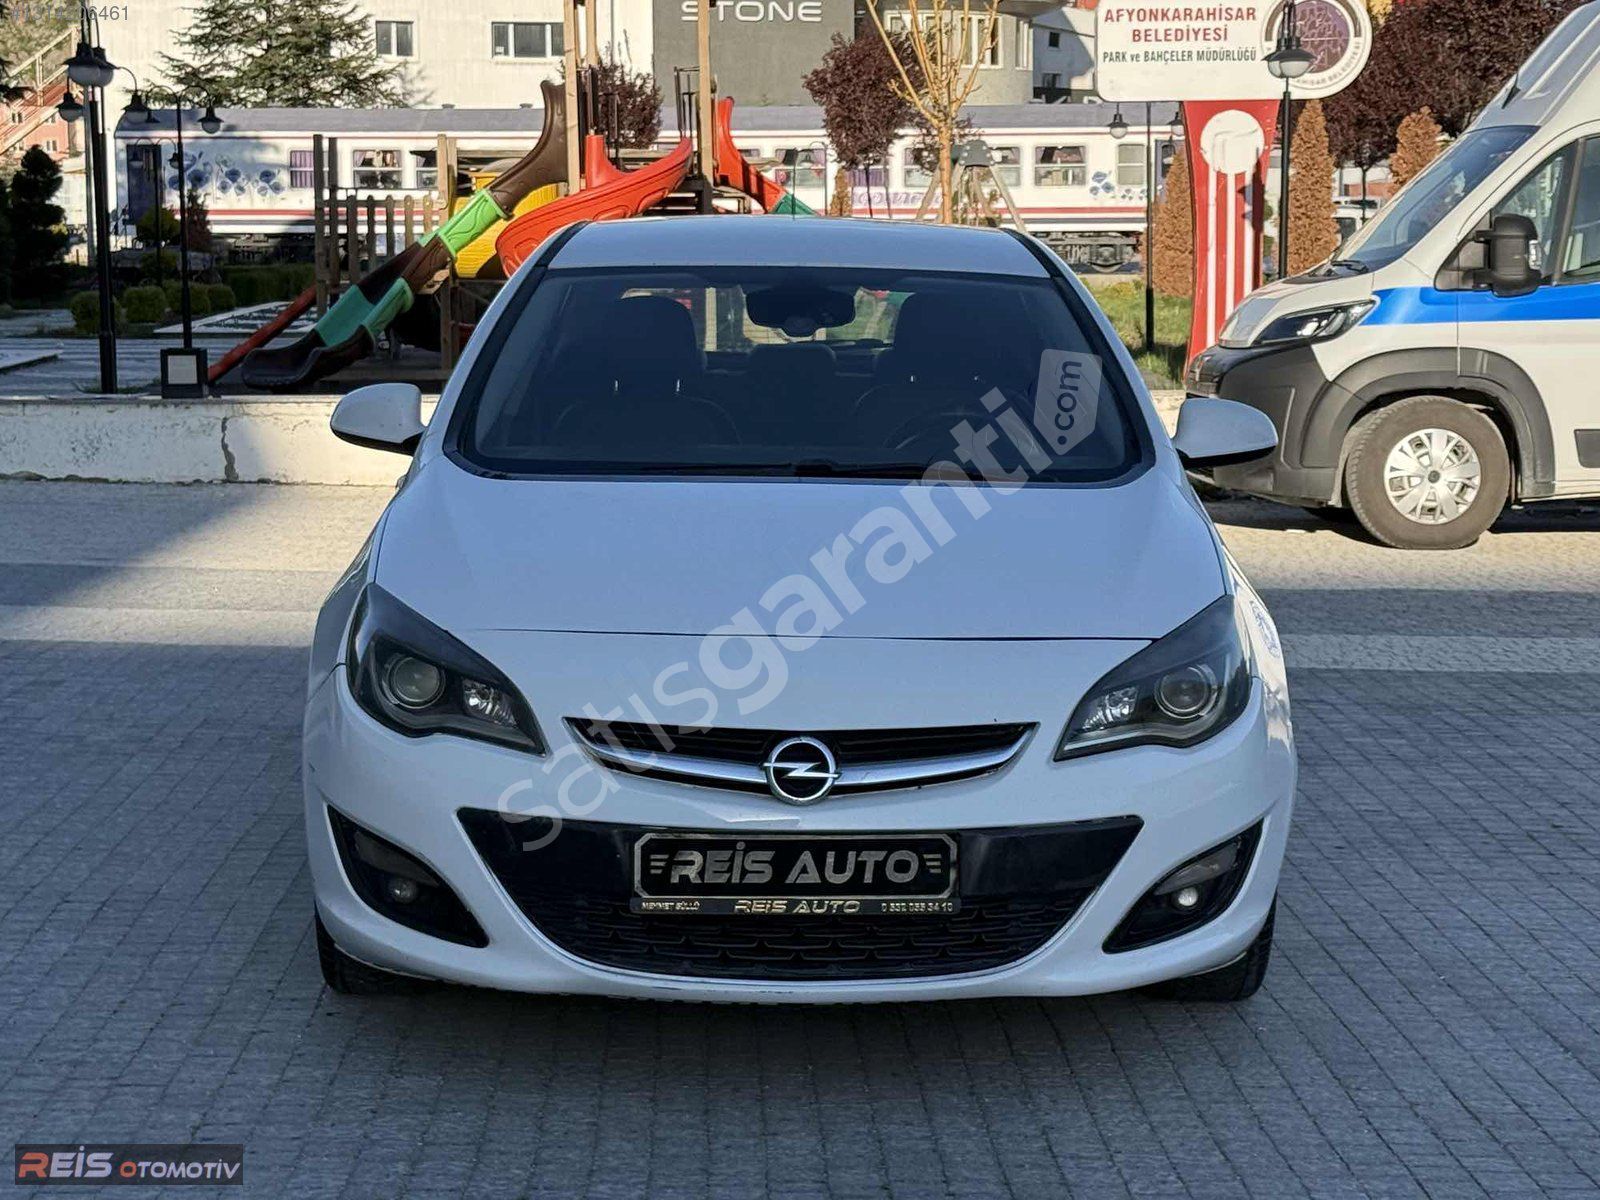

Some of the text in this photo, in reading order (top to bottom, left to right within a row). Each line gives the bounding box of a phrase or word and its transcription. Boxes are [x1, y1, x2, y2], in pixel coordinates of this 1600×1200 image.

[680, 0, 823, 22] STONE
[1104, 4, 1257, 23] AFYONKARAHİSAR
[1131, 24, 1229, 43] BELEDİYESİ
[1102, 47, 1257, 65] PARK ve BAHÇELER MÜDÜRLÜĞÜ
[784, 849, 920, 885] AUTO
[793, 899, 861, 914] AUTO
